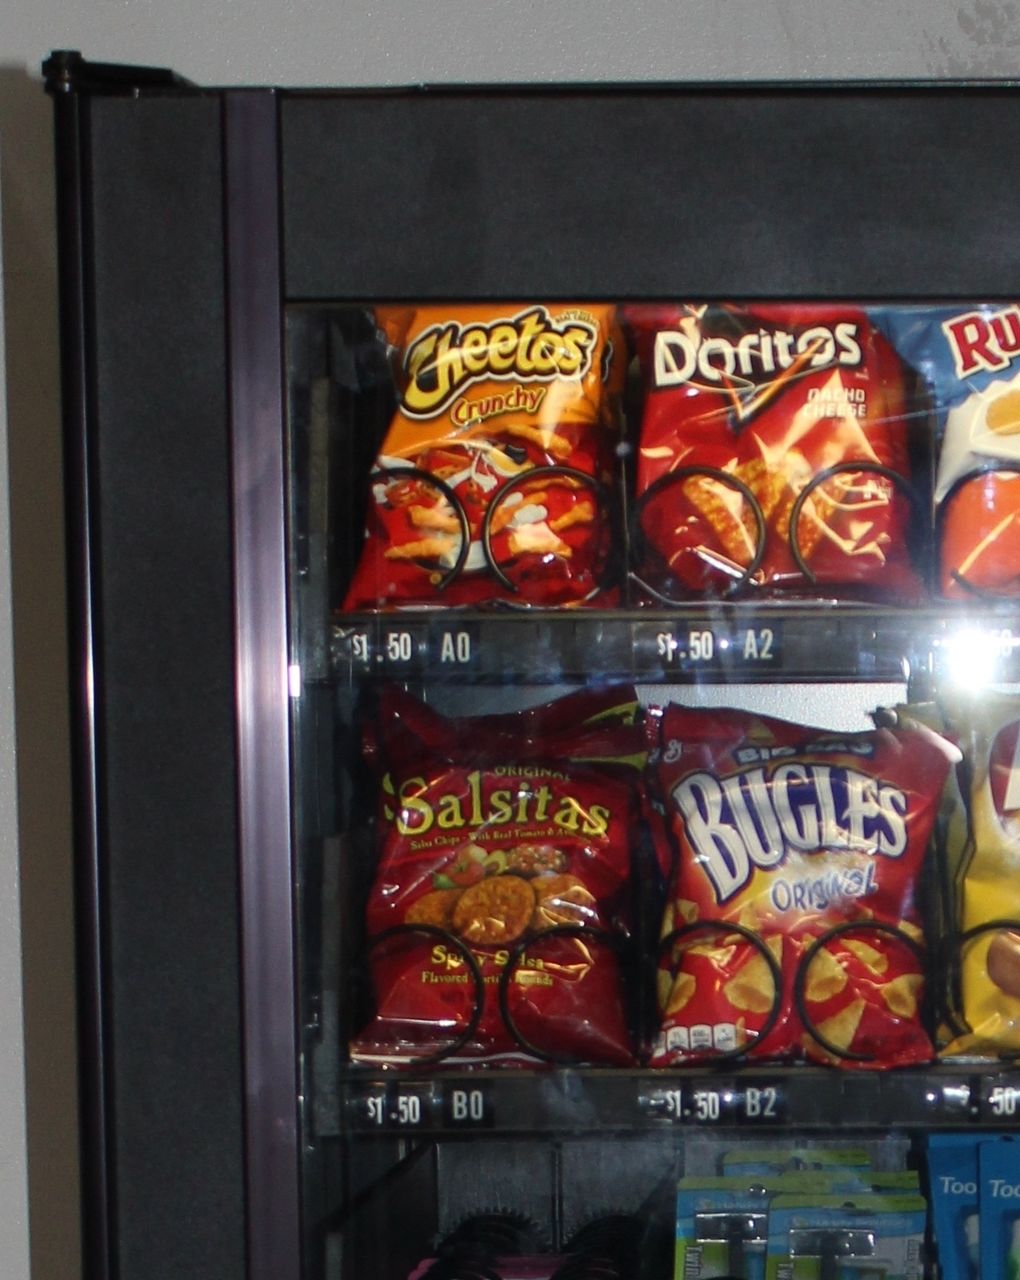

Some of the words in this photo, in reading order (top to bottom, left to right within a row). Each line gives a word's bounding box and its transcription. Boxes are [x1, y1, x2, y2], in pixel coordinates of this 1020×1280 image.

[402, 306, 596, 414] Cheetos
[654, 322, 862, 387] Doritos
[452, 385, 546, 427] Crunchy
[351, 631, 413, 664] $1.50
[441, 631, 471, 663] A0
[743, 629, 774, 660] A2
[395, 771, 611, 836] Salsitas
[672, 764, 908, 905] BUGLES
[367, 1096, 420, 1124] $1.50
[452, 1090, 483, 1120] B0
[666, 1090, 720, 1120] $1.50
[745, 1089, 777, 1117] B2
